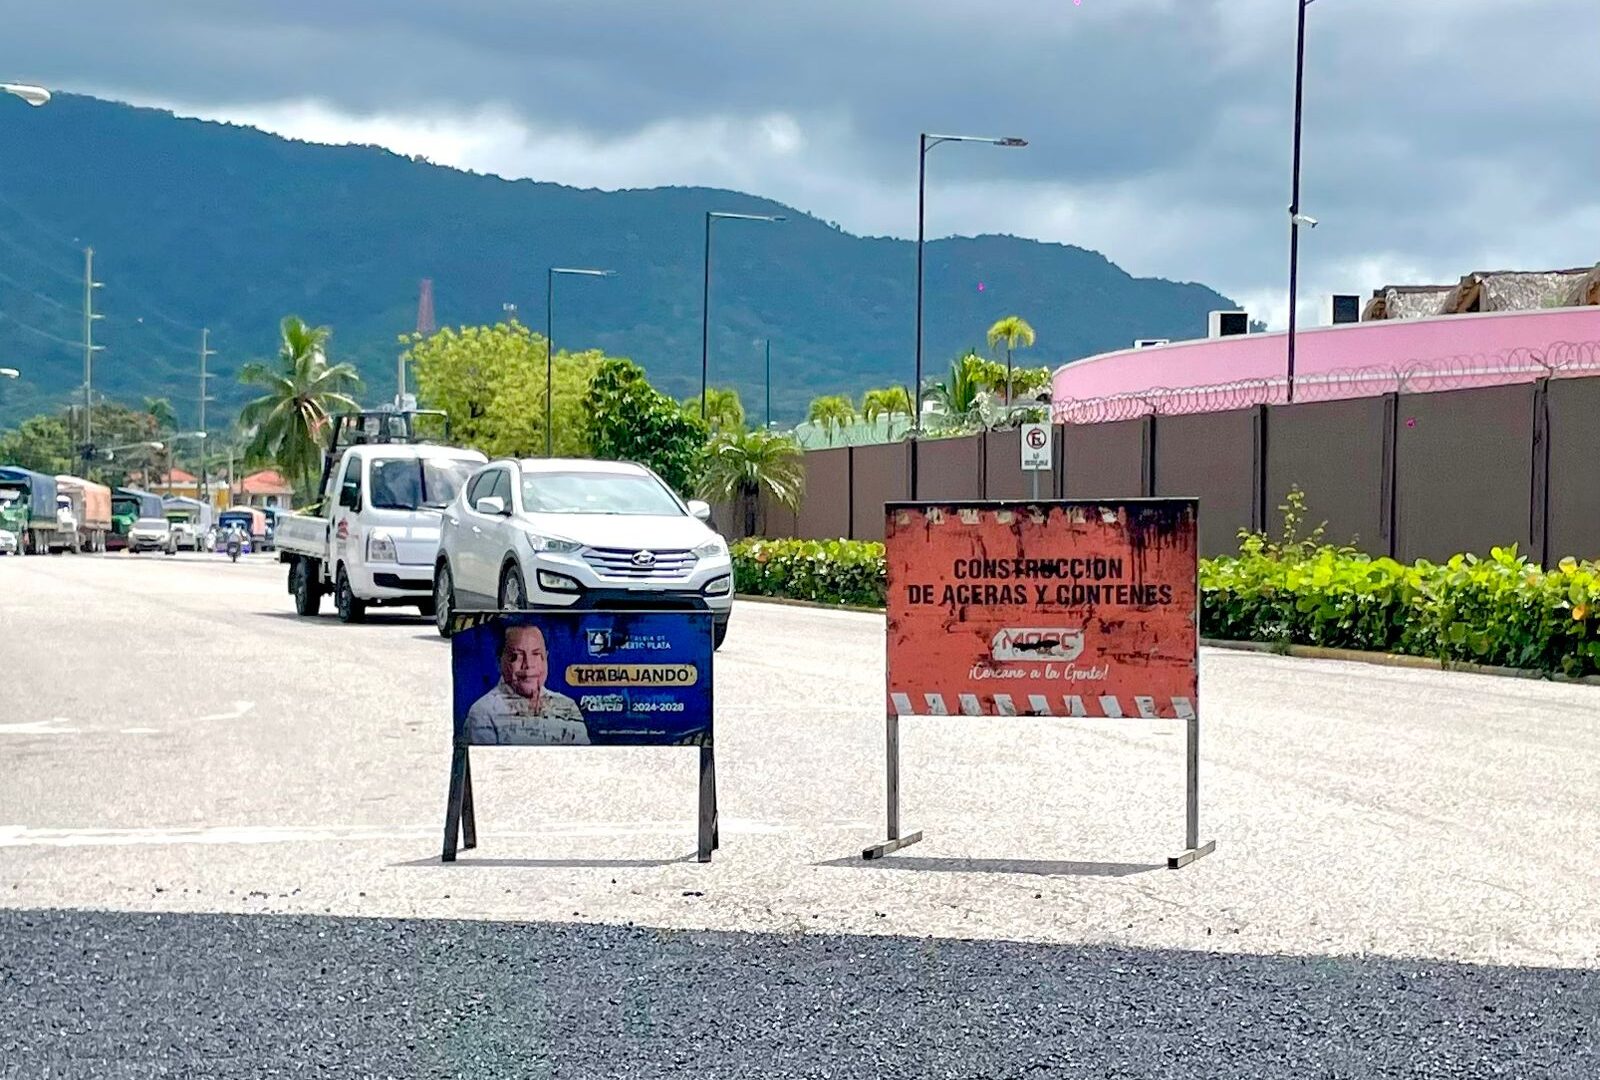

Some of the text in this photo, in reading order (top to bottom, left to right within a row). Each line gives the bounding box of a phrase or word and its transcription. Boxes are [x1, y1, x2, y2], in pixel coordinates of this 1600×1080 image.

[954, 558, 1122, 580] CONSTRUCCION
[908, 584, 1172, 606] DE ACERAS Y CONTENES
[574, 669, 689, 682] TRABAJANDO
[969, 661, 1110, 684] ¡Cercano a la Gente!
[632, 702, 685, 712] 2024-2028
